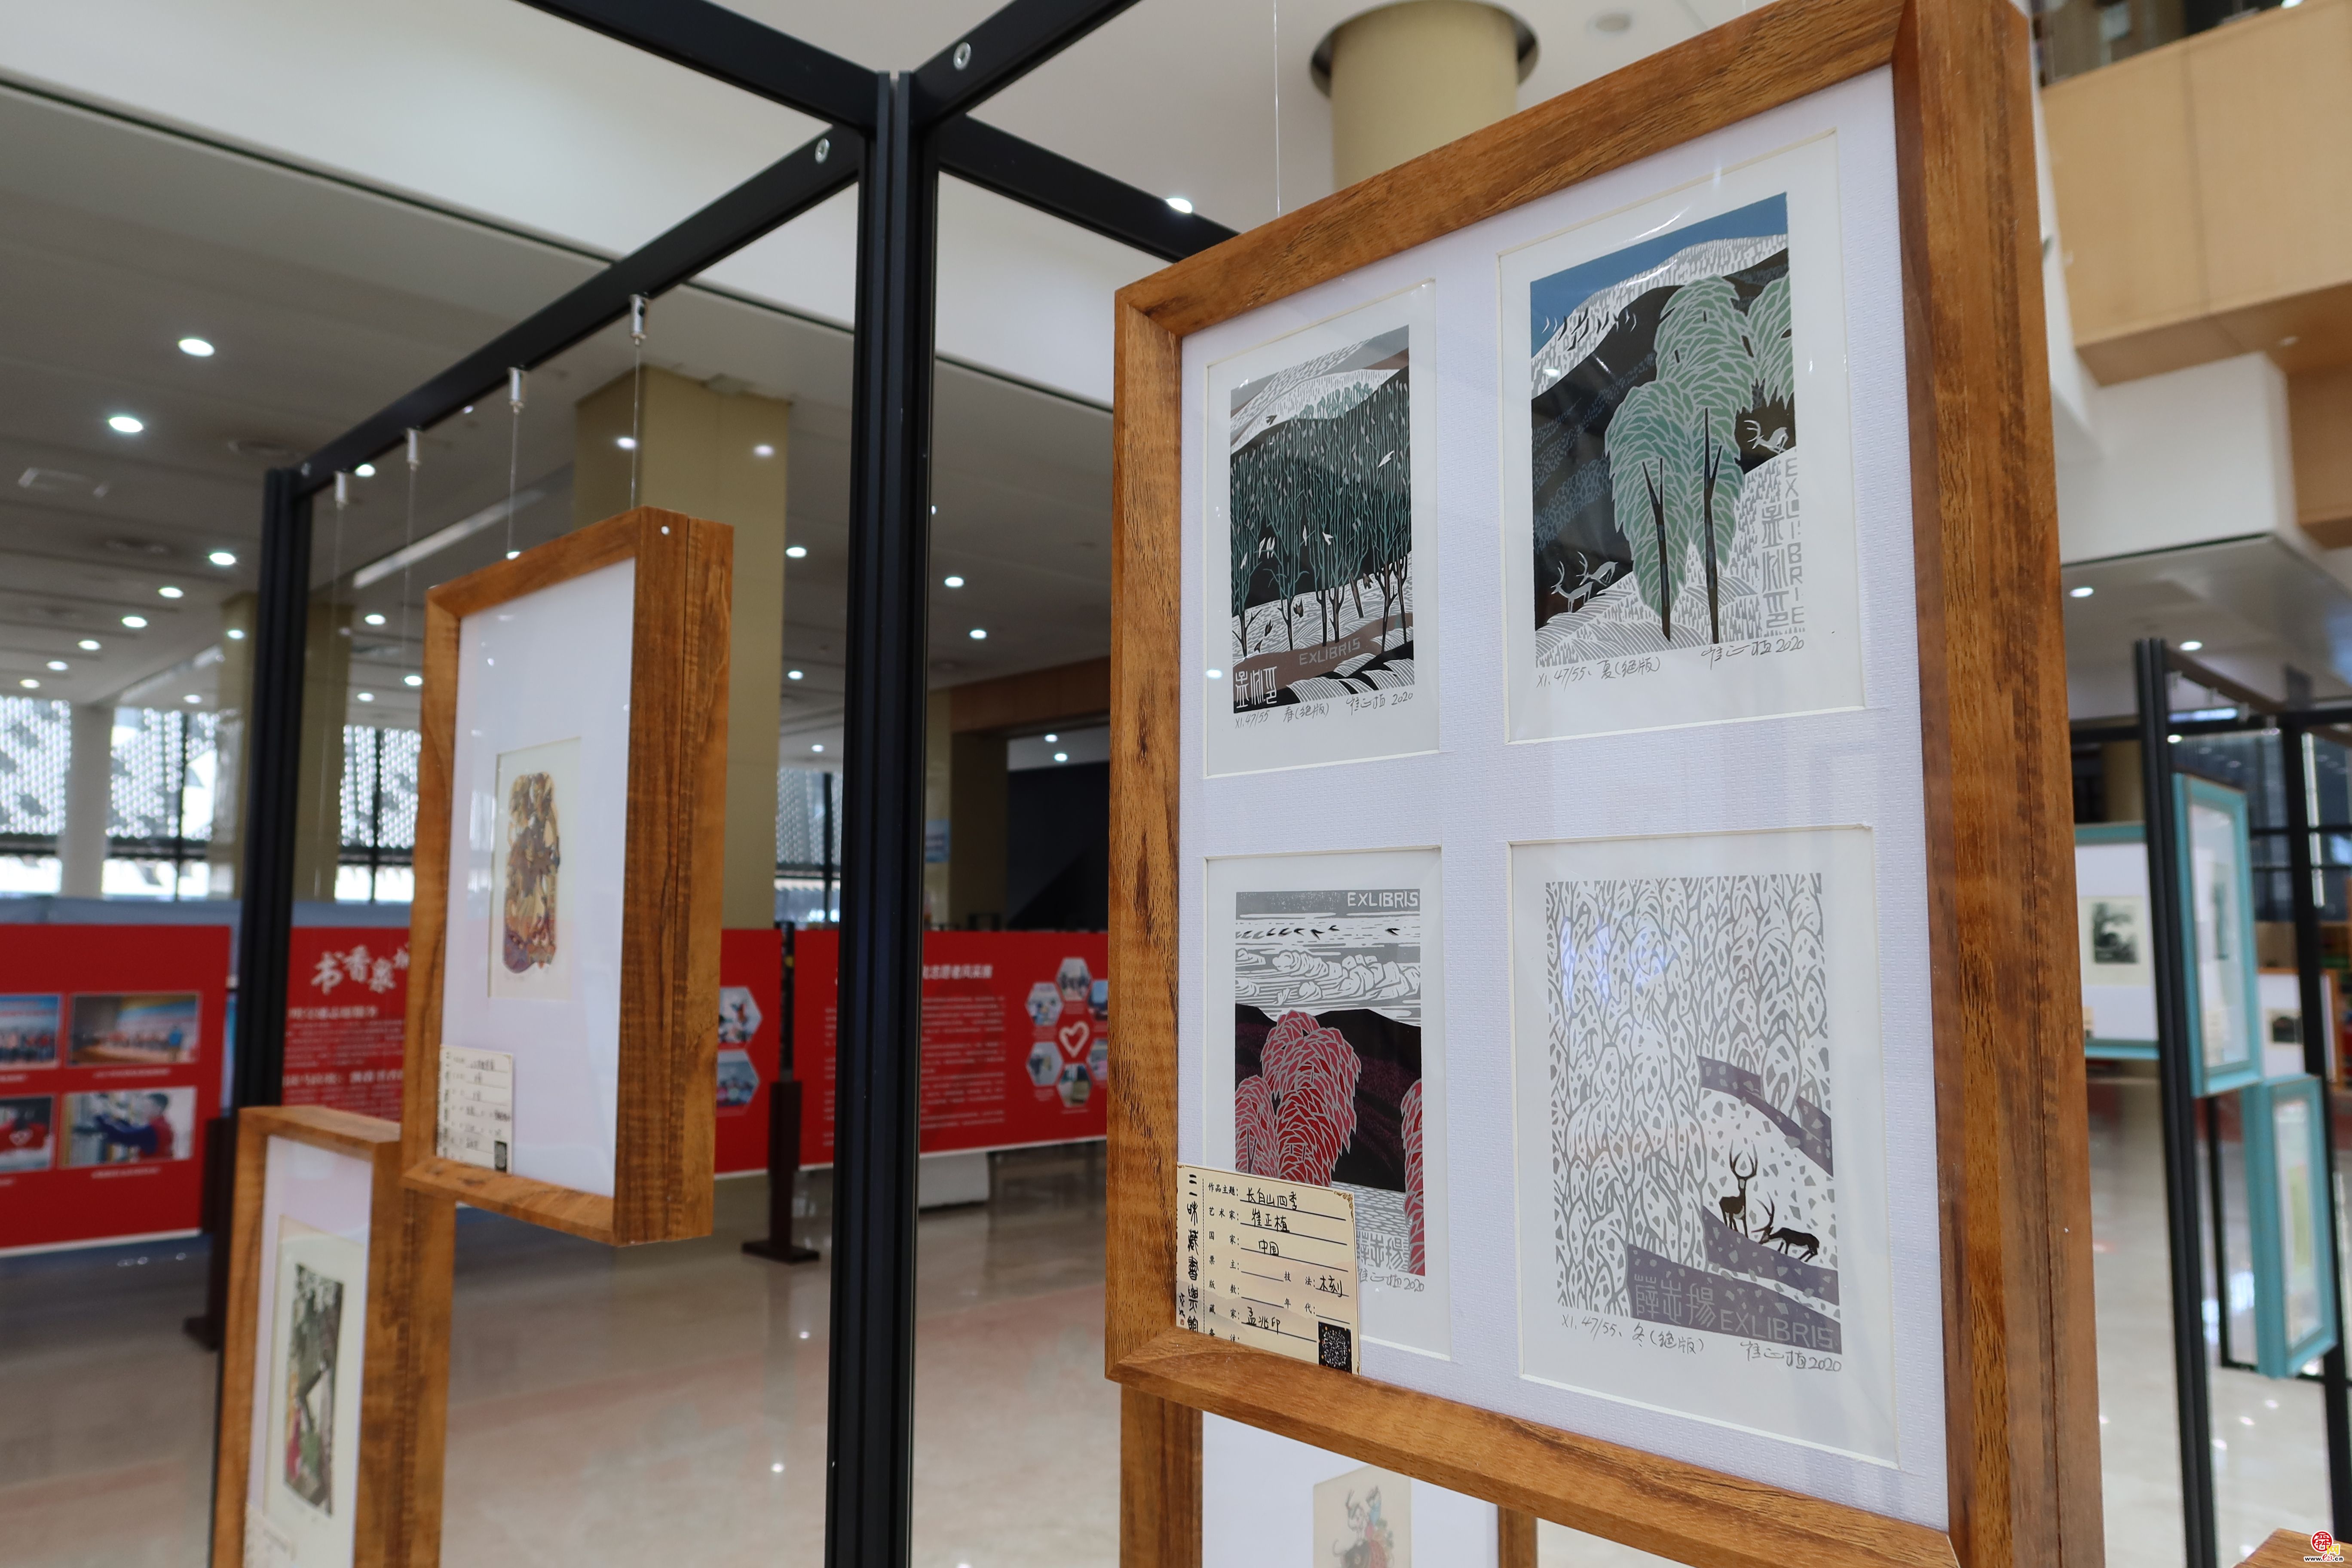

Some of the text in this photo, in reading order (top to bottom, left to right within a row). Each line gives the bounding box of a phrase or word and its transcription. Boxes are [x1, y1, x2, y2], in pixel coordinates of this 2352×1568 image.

[1299, 637, 1360, 665] EXLIBRIS
[1776, 636, 1804, 652] 2020
[1391, 691, 1413, 706] 2020
[1348, 891, 1418, 908] EXLIBRIS
[1208, 1182, 1238, 1196] 作品主题:
[1252, 1208, 1290, 1232] 崔正植
[1258, 1239, 1279, 1256] 中国
[1319, 1275, 1342, 1297] 木刻
[1404, 1277, 1424, 1292] 2020
[1246, 1307, 1280, 1335] 孟兆印
[1721, 1309, 1833, 1349] EXLIBRIS
[1808, 1357, 1842, 1372] 2020
